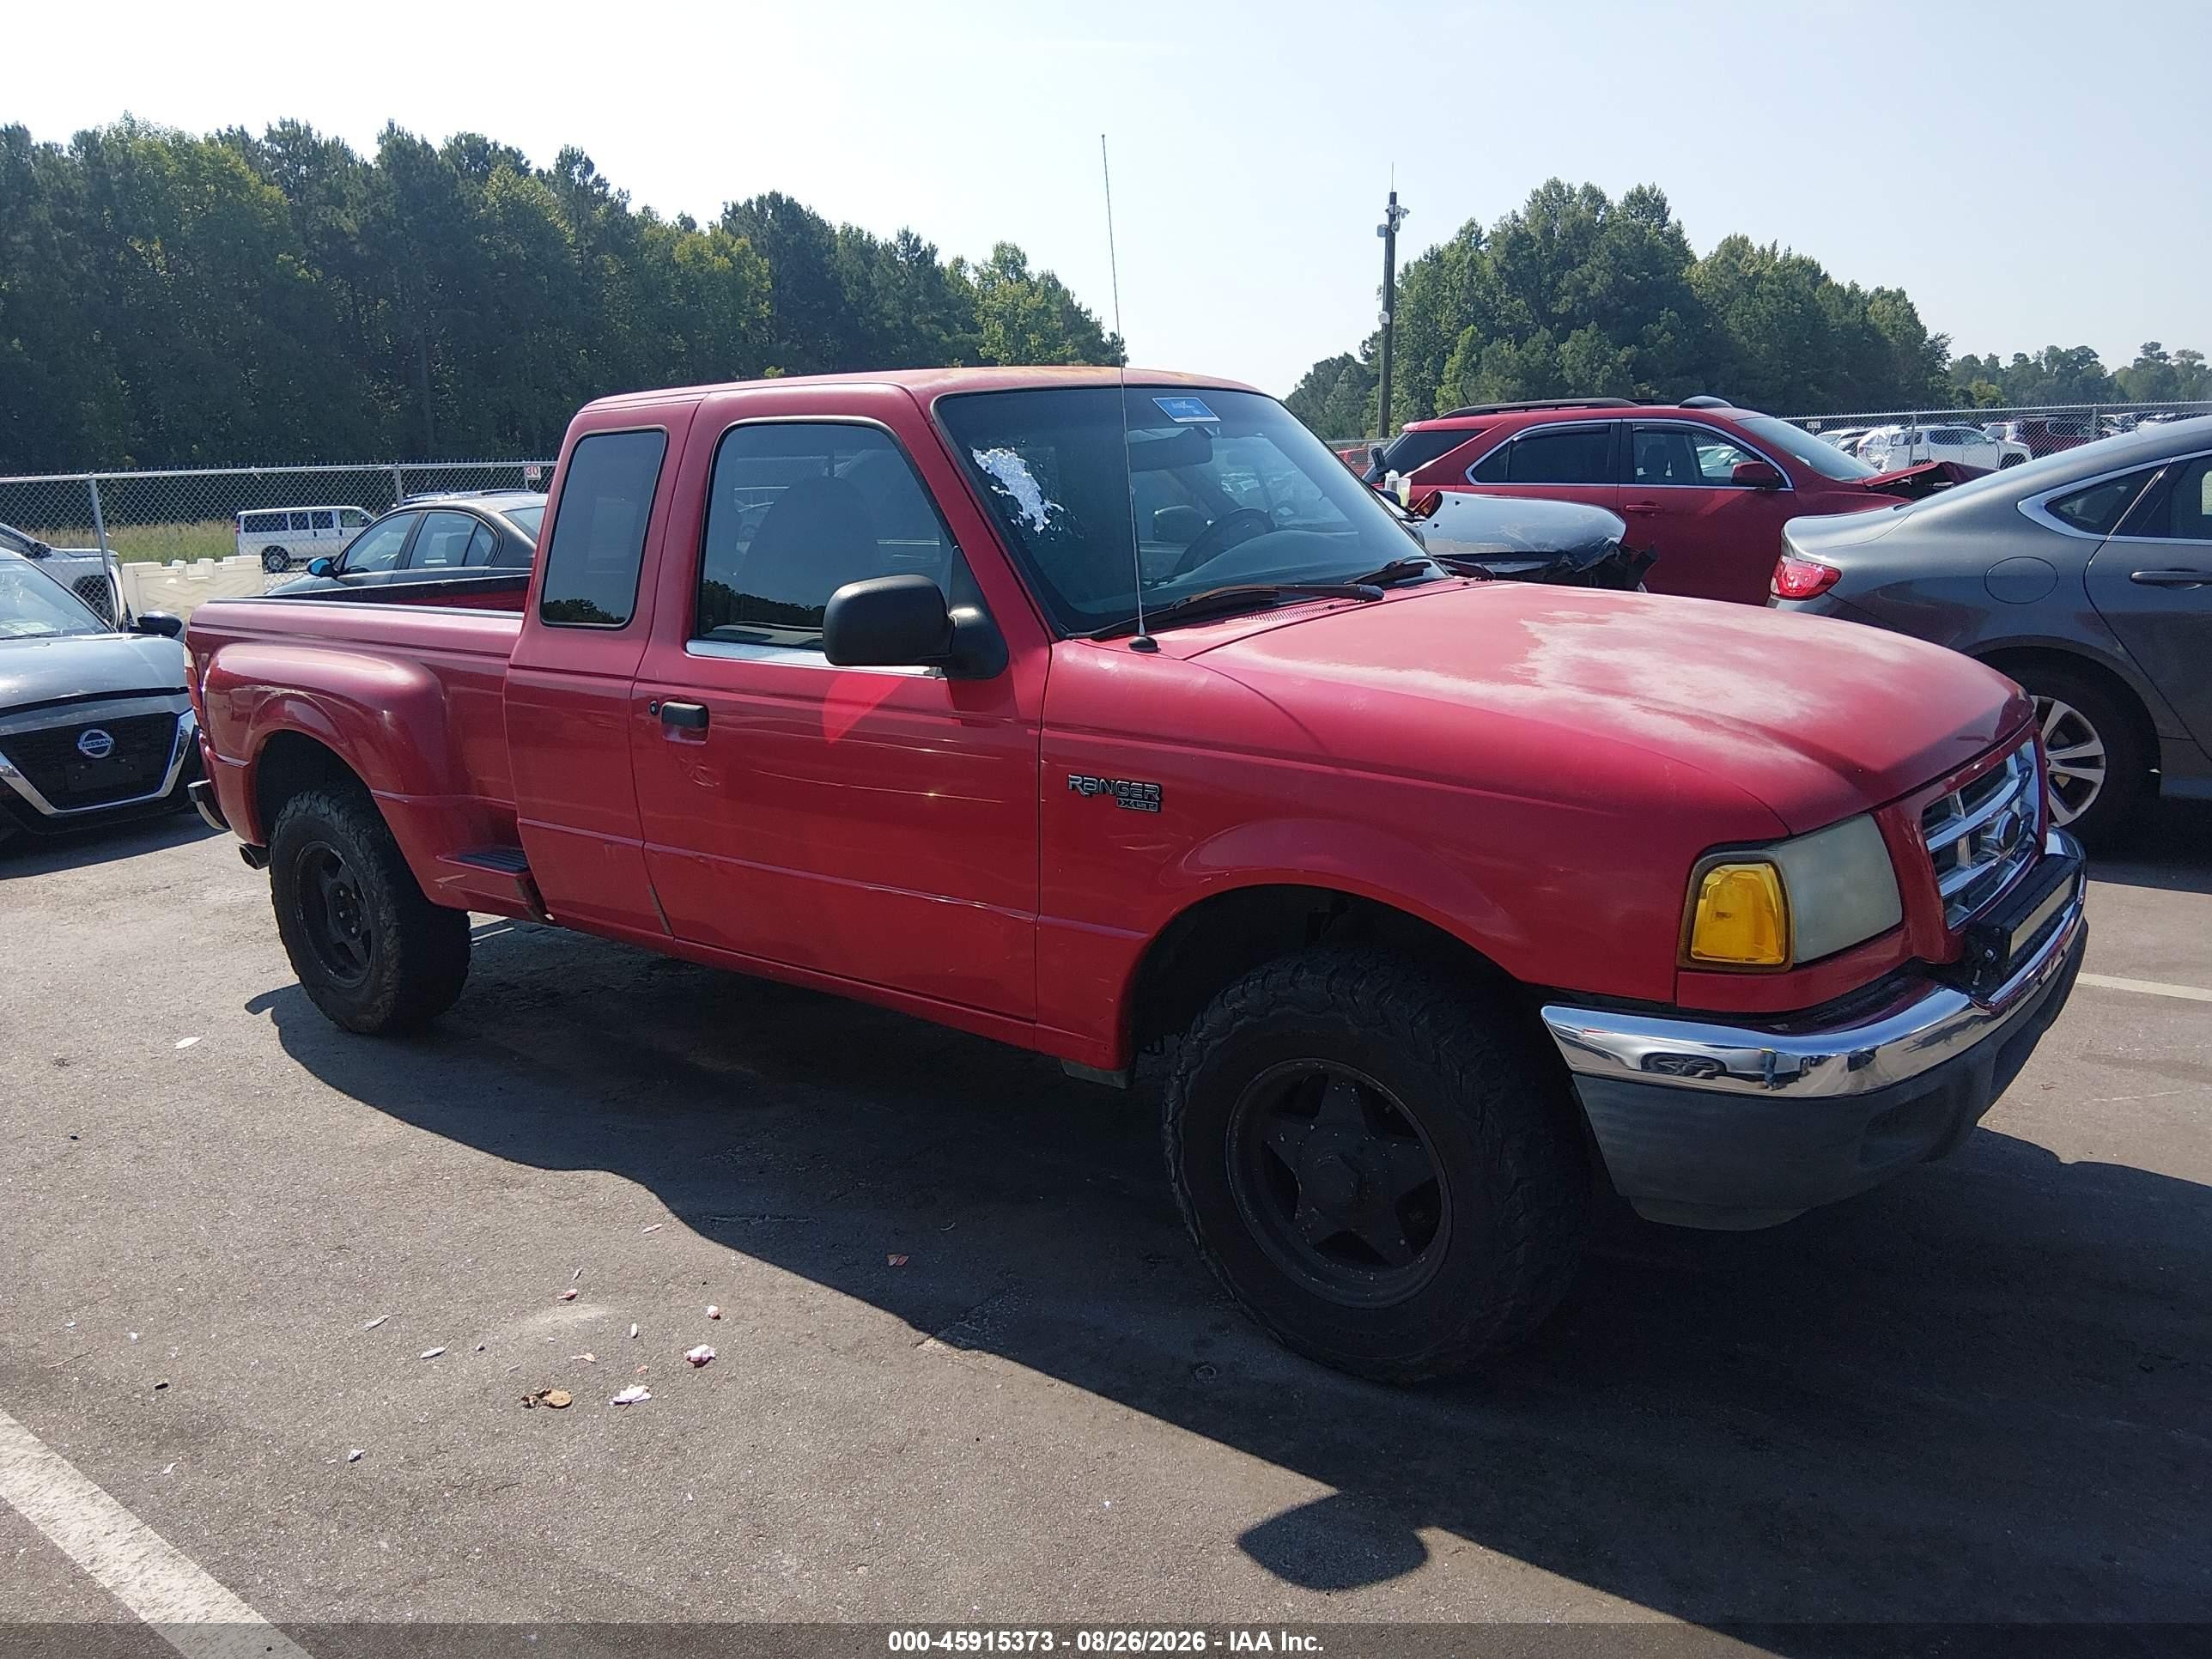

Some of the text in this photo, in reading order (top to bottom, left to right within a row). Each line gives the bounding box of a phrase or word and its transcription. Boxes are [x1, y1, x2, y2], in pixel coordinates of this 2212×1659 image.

[526, 466, 538, 476] 30
[82, 739, 111, 748] NISSAN
[1067, 775, 1160, 801] RANGER
[1117, 799, 1158, 811] XLT
